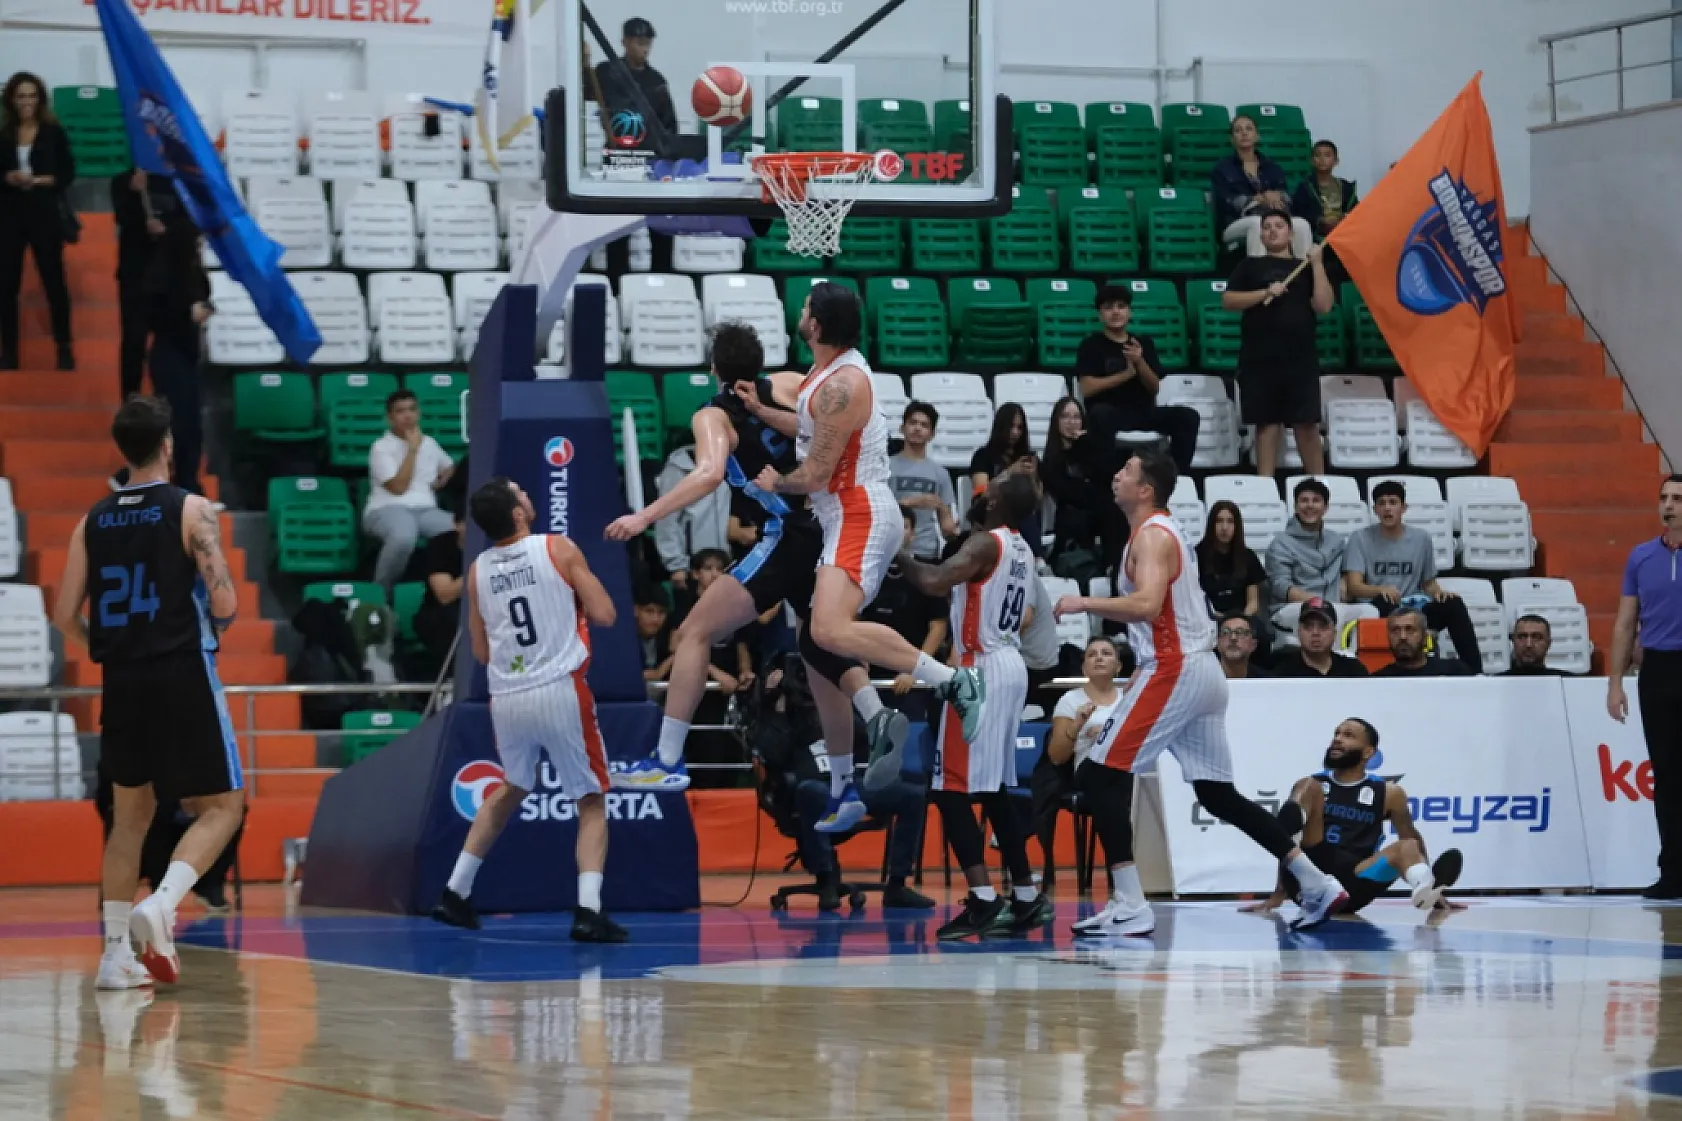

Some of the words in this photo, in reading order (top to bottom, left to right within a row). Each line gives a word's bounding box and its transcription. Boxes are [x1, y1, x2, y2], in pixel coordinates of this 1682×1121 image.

[725, 0, 843, 16] www.tbf.org.tr
[904, 152, 964, 179] TBF
[100, 562, 160, 626] 24
[508, 596, 538, 647] 9
[1325, 825, 1342, 844] 6
